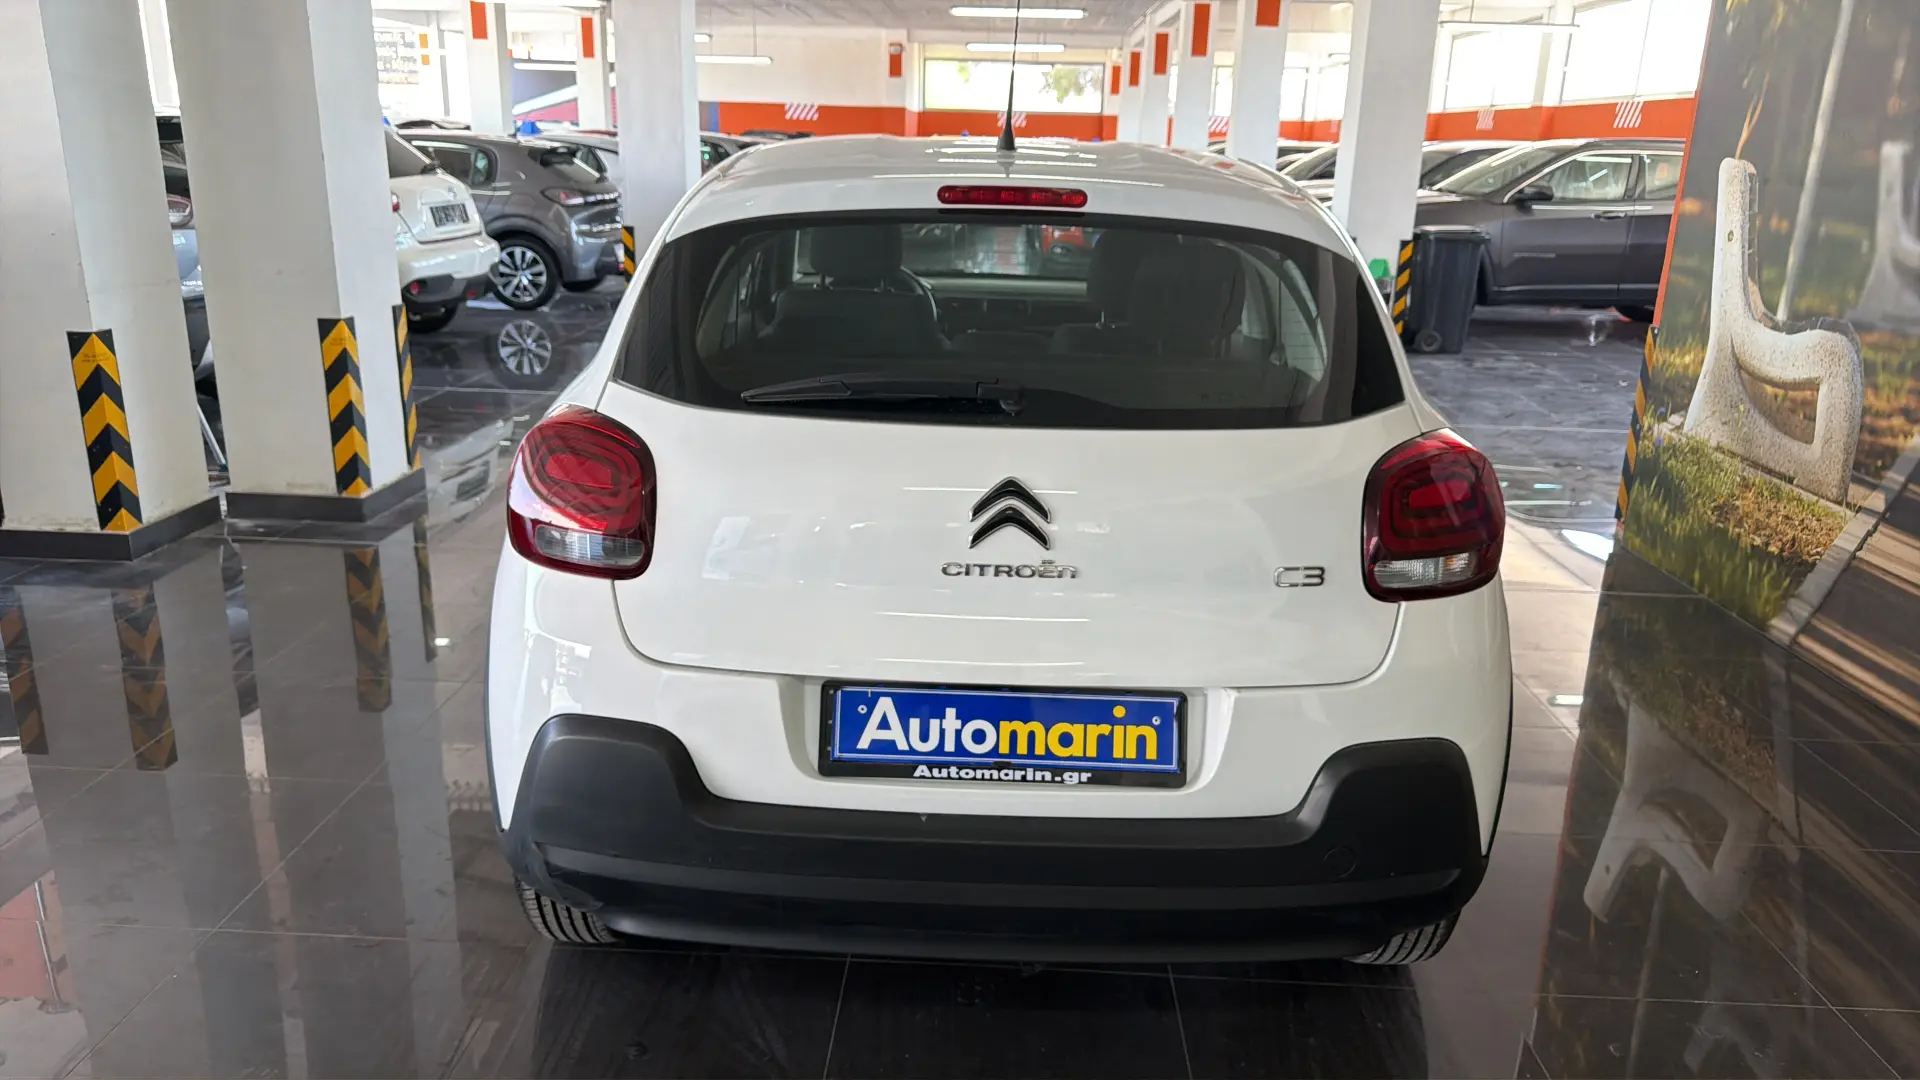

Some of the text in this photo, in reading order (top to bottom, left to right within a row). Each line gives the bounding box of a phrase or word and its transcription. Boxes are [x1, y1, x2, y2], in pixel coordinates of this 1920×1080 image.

[1273, 566, 1326, 588] C3
[856, 696, 1158, 760] Automarin
[912, 764, 1092, 784] Automarin.gr
